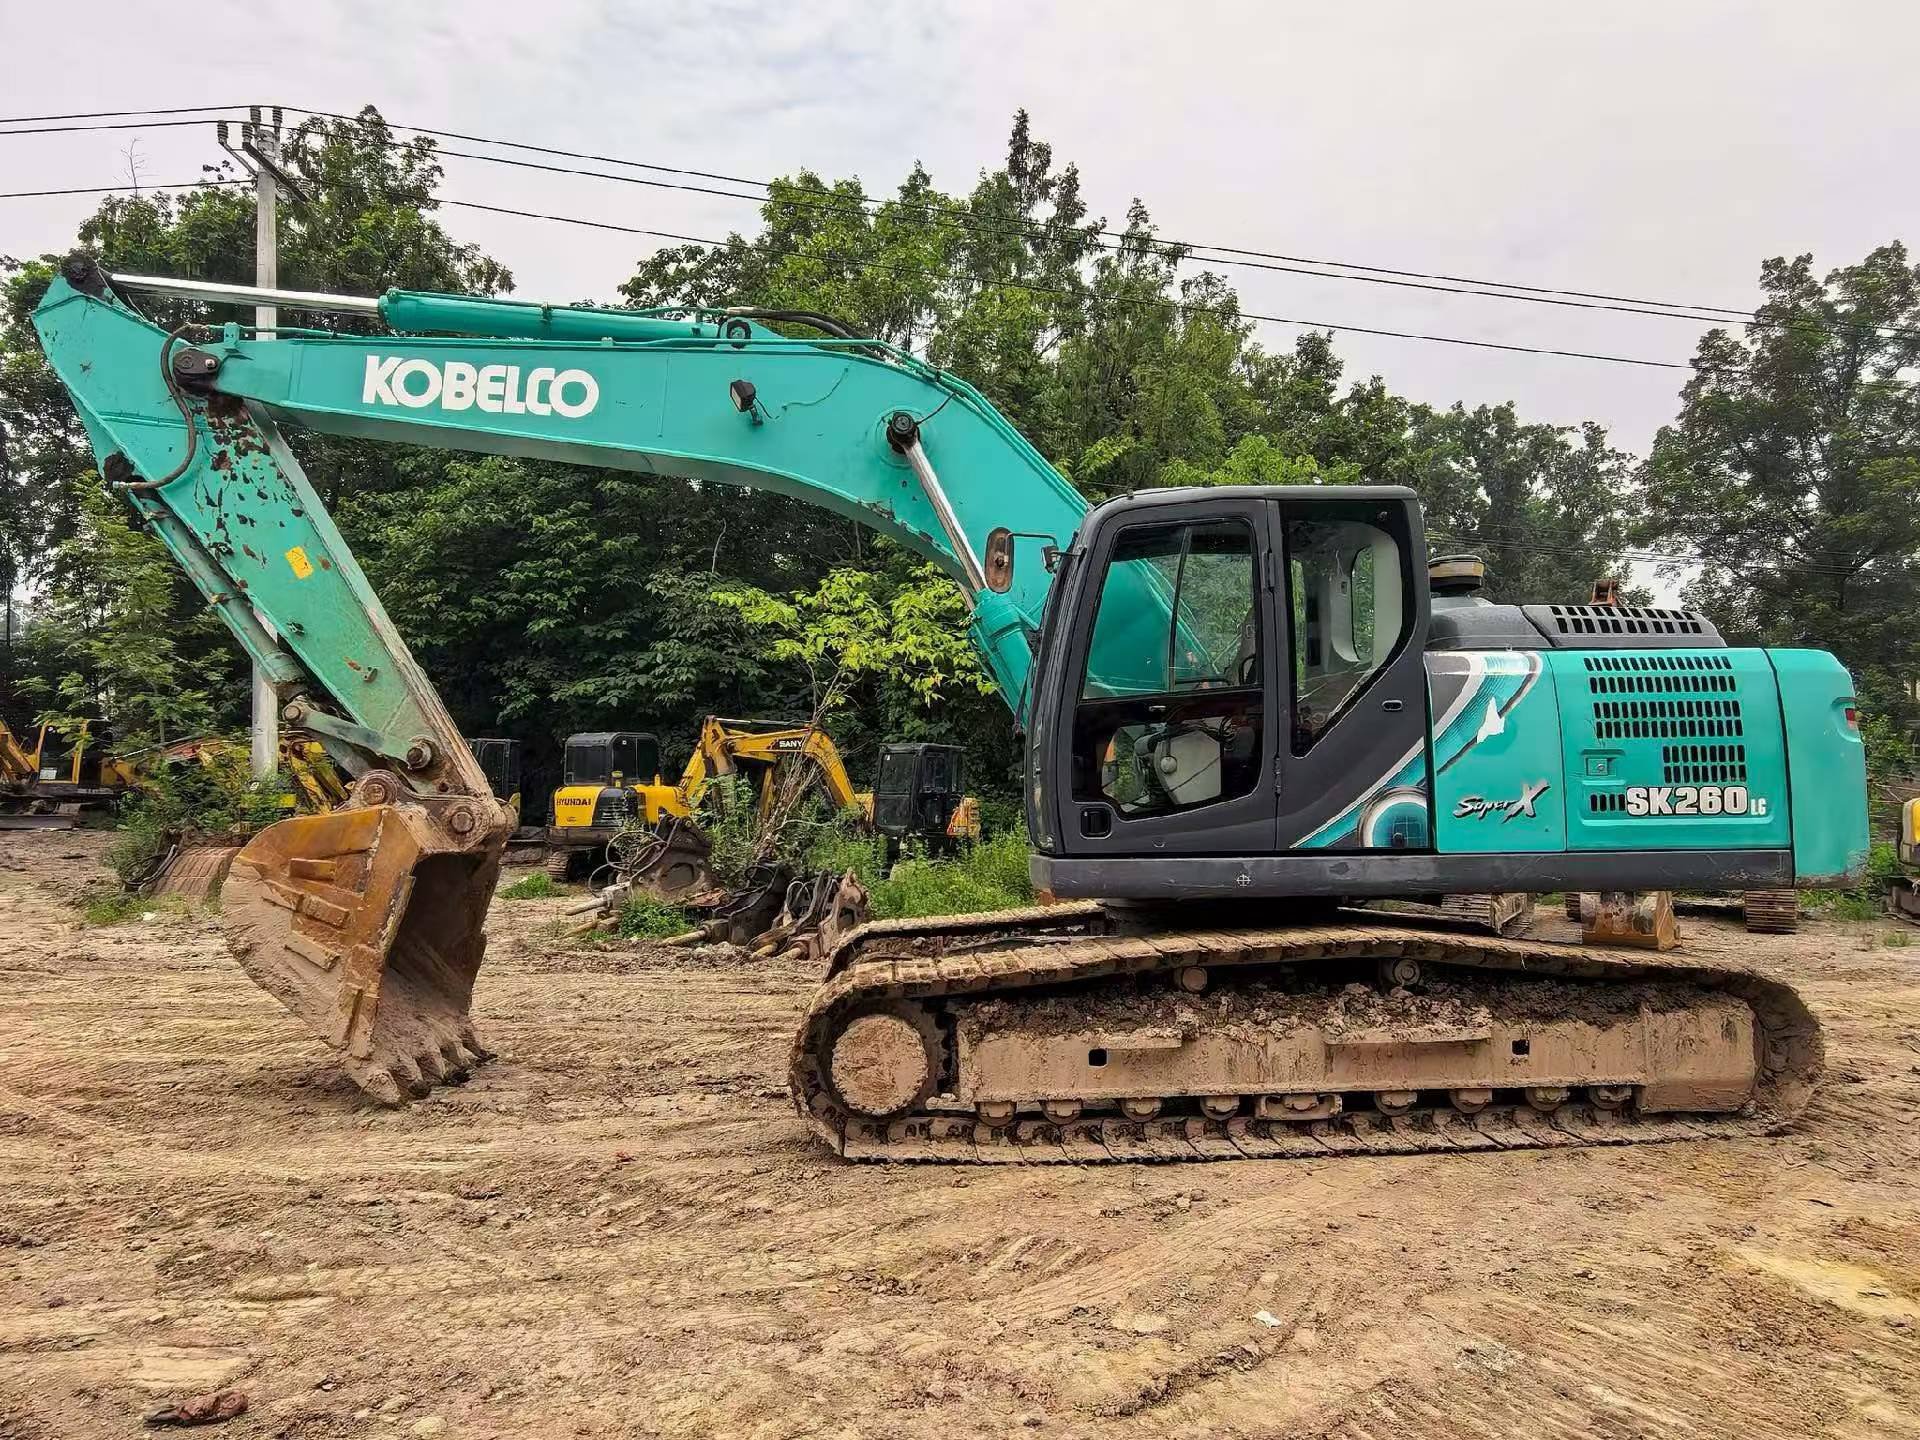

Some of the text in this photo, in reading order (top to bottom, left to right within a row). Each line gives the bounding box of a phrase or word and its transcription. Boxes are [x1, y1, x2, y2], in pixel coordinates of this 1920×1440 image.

[362, 354, 600, 418] KOBELCO
[779, 740, 803, 748] SANY
[556, 798, 592, 806] HYUNDAI
[1626, 786, 1750, 816] SK260
